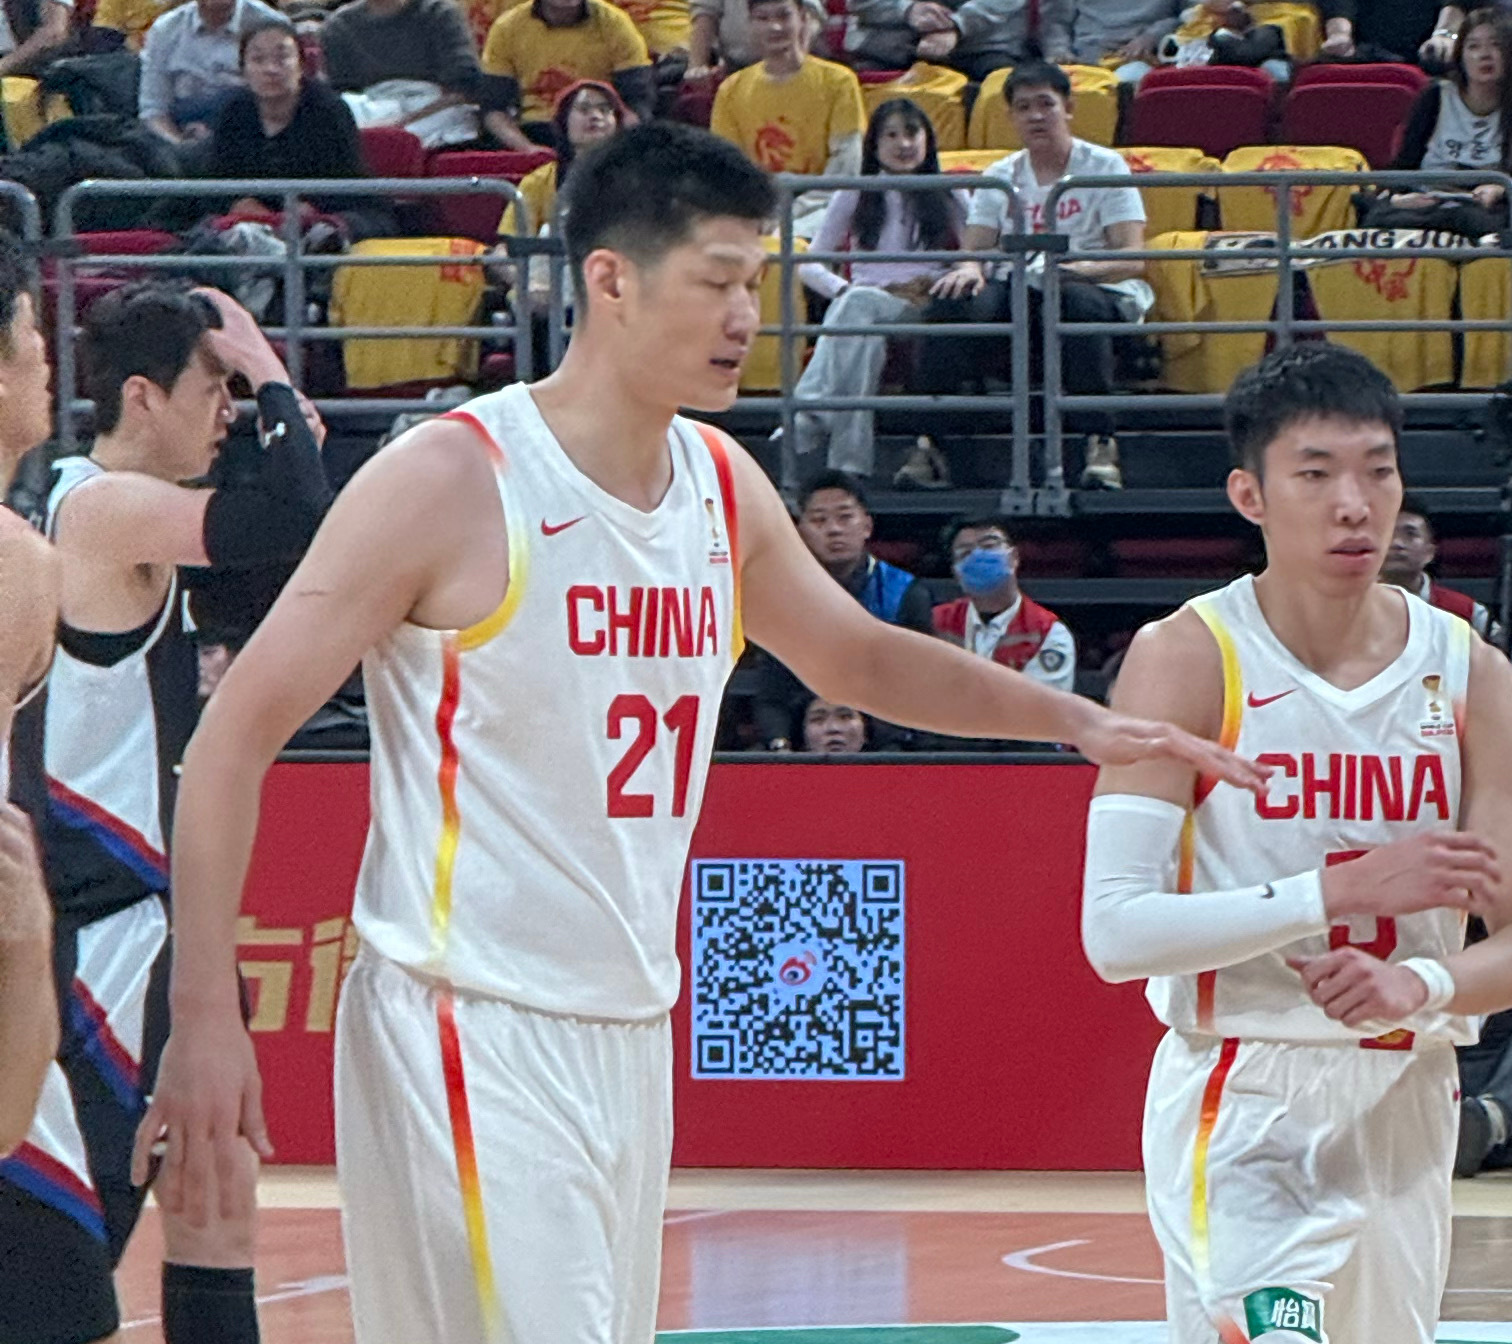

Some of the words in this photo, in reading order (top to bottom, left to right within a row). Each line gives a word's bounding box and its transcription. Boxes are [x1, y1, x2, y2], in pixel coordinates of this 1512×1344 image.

[566, 585, 718, 658] CHINA
[606, 693, 701, 819] 21
[1255, 752, 1450, 821] CHINA
